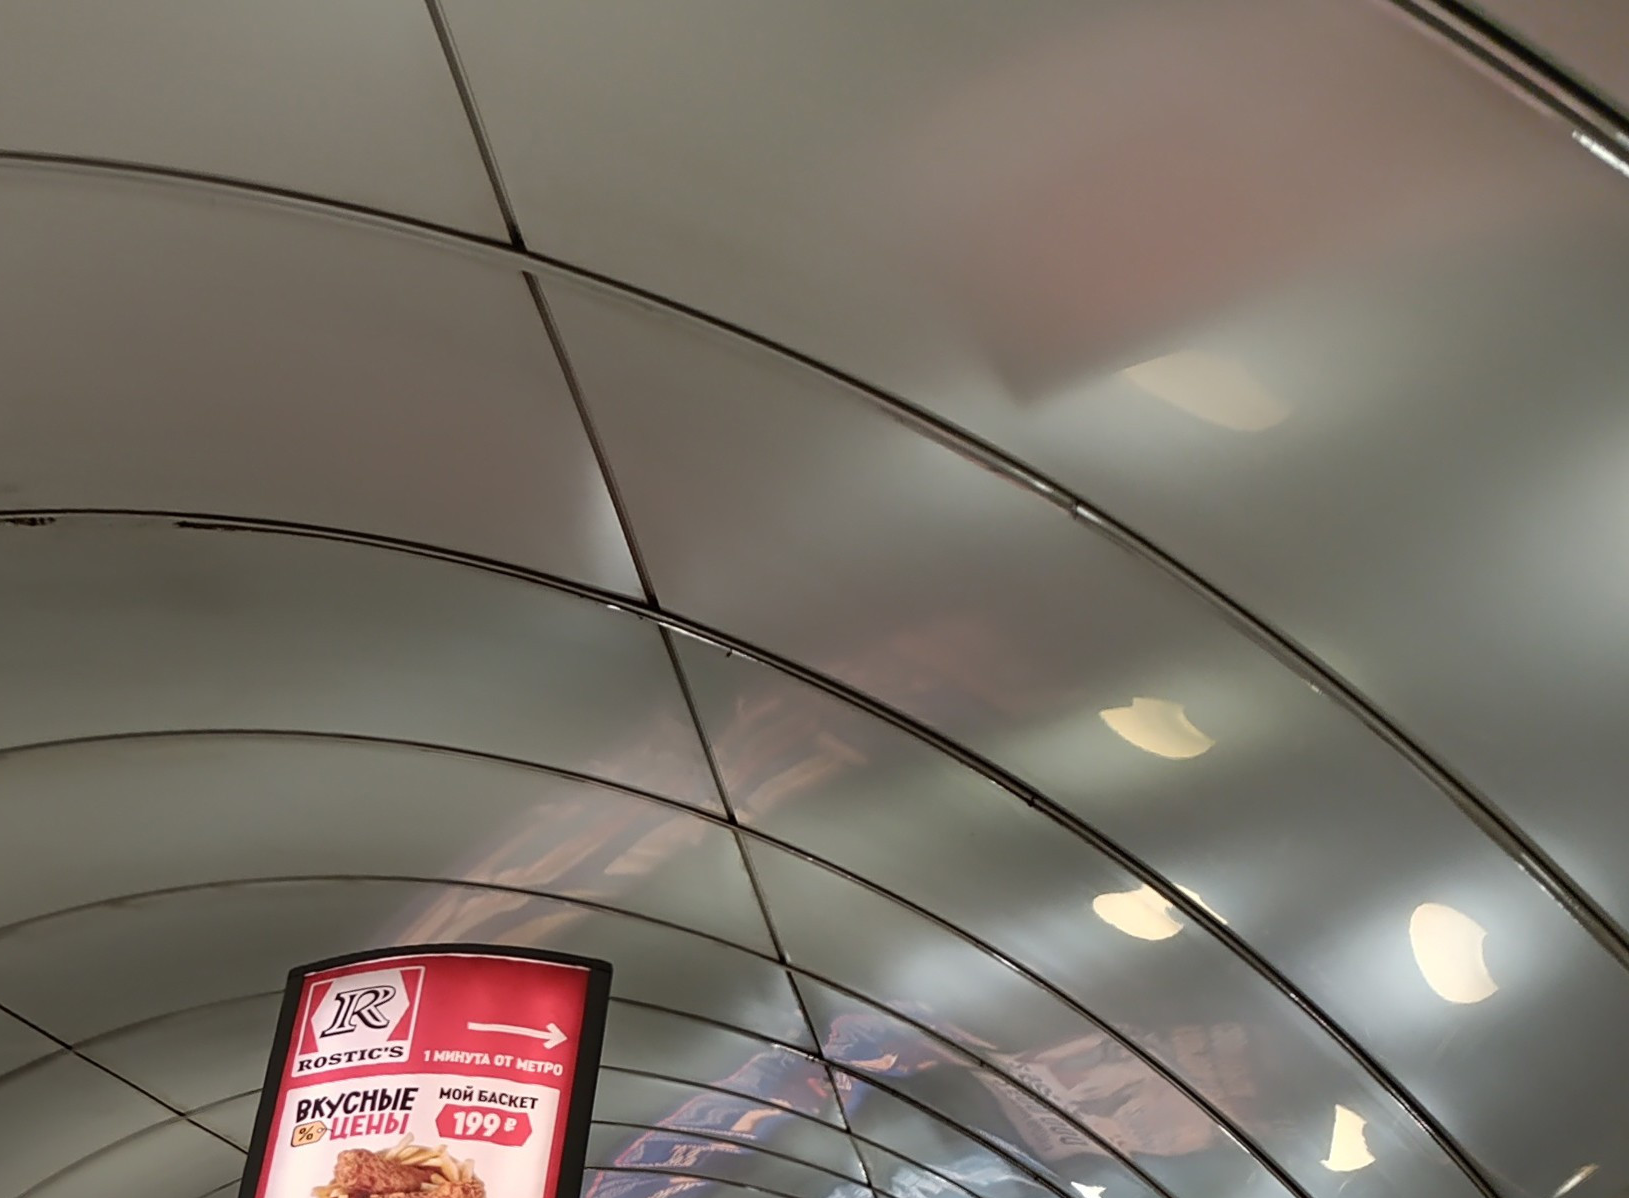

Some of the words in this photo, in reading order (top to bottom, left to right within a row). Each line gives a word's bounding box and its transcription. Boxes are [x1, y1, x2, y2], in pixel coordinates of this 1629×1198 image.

[297, 1046, 404, 1072] ROSTIC'S
[423, 1050, 431, 1062] 1
[433, 1050, 491, 1065] МИНУТА
[494, 1054, 514, 1067] ОТ
[516, 1059, 564, 1077] МЕТРО
[296, 1087, 419, 1123] ВКУСНЫЕ
[439, 1086, 474, 1102] МОЙ
[477, 1090, 538, 1109] БАСКЕТ
[330, 1112, 410, 1141] ЦЕНЫ
[453, 1110, 501, 1137] 199
